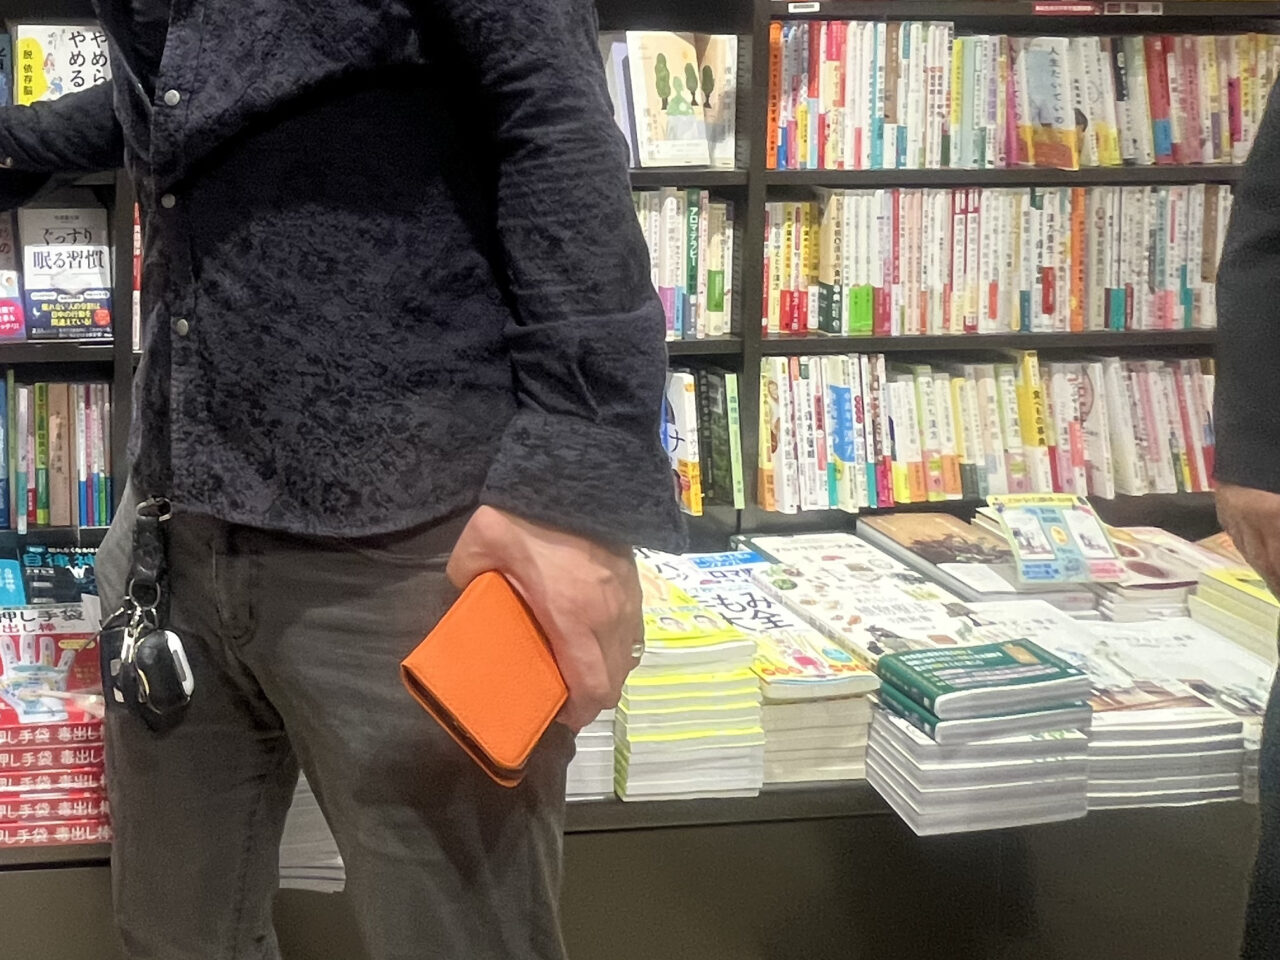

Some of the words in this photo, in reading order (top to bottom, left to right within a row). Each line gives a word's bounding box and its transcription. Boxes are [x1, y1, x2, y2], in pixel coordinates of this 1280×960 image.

[69, 30, 86, 88] やめる
[1048, 45, 1066, 126] 人生たいていの
[42, 227, 93, 246] ぐっすり
[32, 249, 105, 270] 眠る習慣
[56, 726, 104, 742] 毒出し
[60, 748, 105, 764] 毒出し
[58, 776, 106, 790] 毒出し
